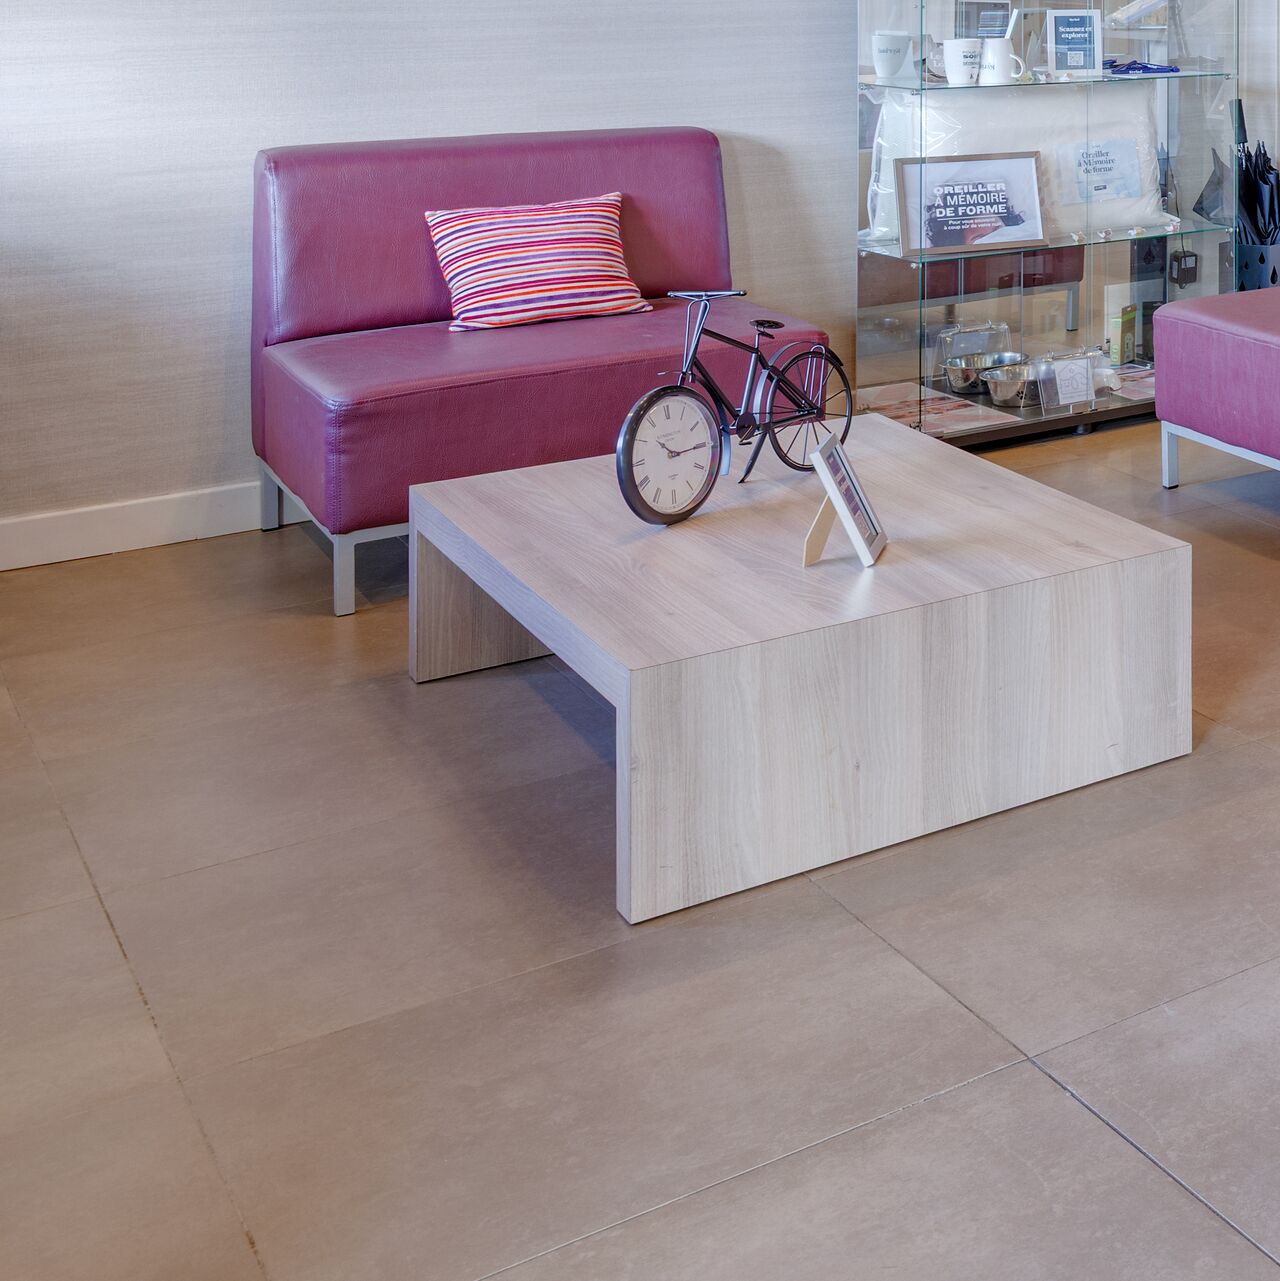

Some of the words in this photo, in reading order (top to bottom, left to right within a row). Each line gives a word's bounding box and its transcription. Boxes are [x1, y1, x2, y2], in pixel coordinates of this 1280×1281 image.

[1082, 150, 1109, 159] Oreiller
[934, 183, 1006, 195] OREILLER
[947, 192, 1007, 206] MÉMOIRE
[936, 207, 955, 217] DE
[958, 204, 1007, 215] FORME
